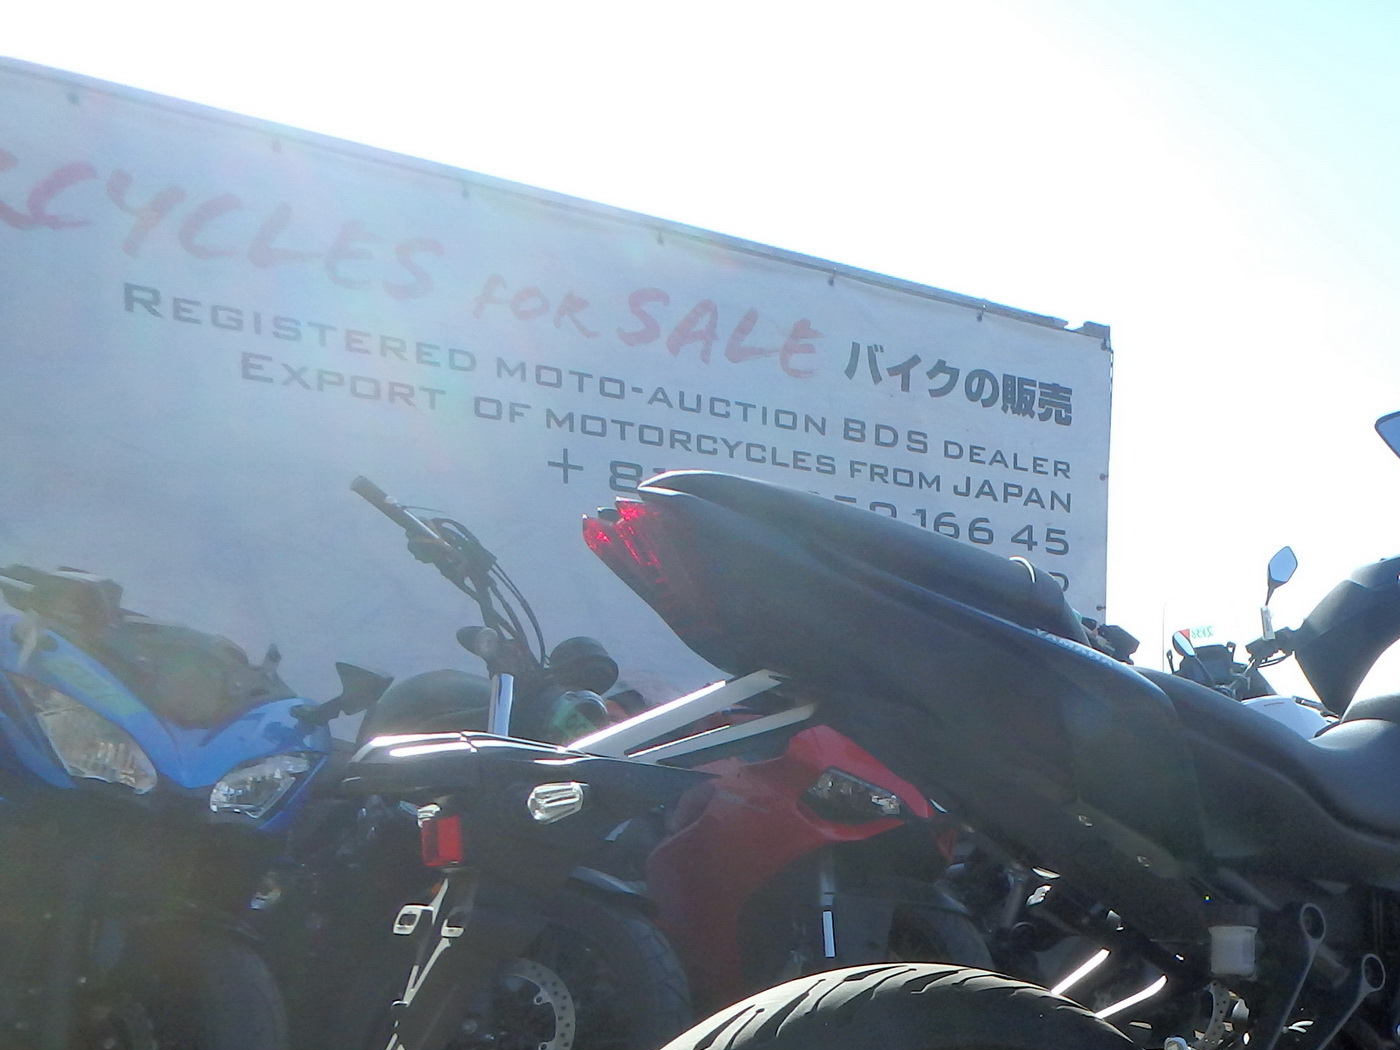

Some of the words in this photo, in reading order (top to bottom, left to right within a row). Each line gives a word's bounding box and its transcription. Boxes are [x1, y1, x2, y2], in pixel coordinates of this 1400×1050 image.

[617, 287, 824, 379] SALE
[123, 282, 477, 373] REGISTERED
[496, 356, 827, 436] MOTO-AUCTION
[843, 418, 928, 454] BDS
[944, 440, 1071, 479] DEALER
[844, 342, 1073, 426] バイクの販売
[241, 351, 445, 410] EXPORT
[474, 395, 531, 423] OF
[546, 407, 836, 476] MOTORCYCLES
[850, 460, 941, 493] FROM
[953, 476, 1071, 513] JAPAN
[1011, 524, 1070, 556] 45
